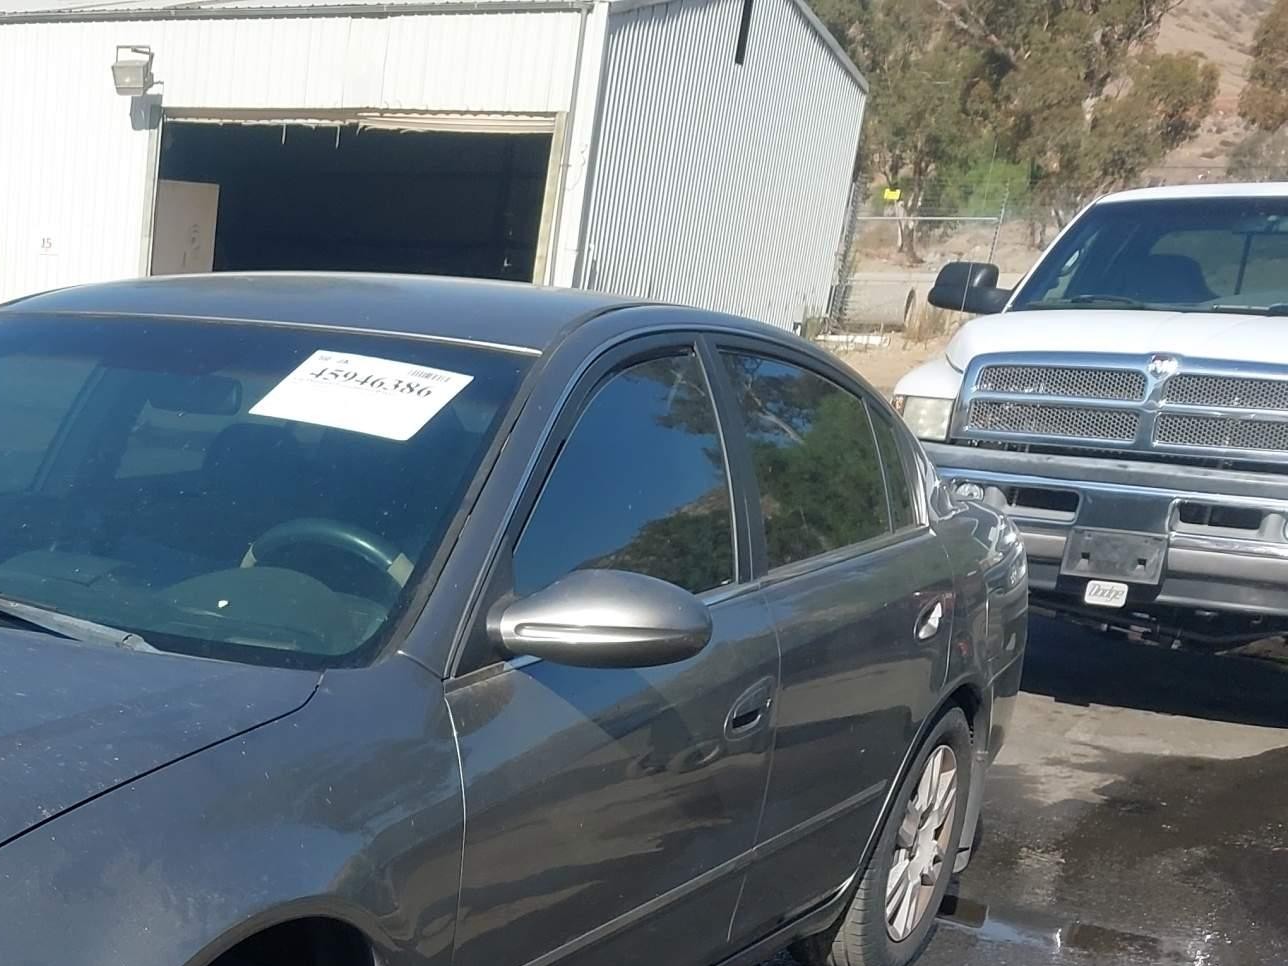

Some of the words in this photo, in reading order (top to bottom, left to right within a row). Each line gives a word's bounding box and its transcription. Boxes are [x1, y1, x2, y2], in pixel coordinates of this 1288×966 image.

[41, 237, 53, 249] 15
[310, 367, 432, 398] 45946386
[1088, 583, 1126, 601] Dodge
